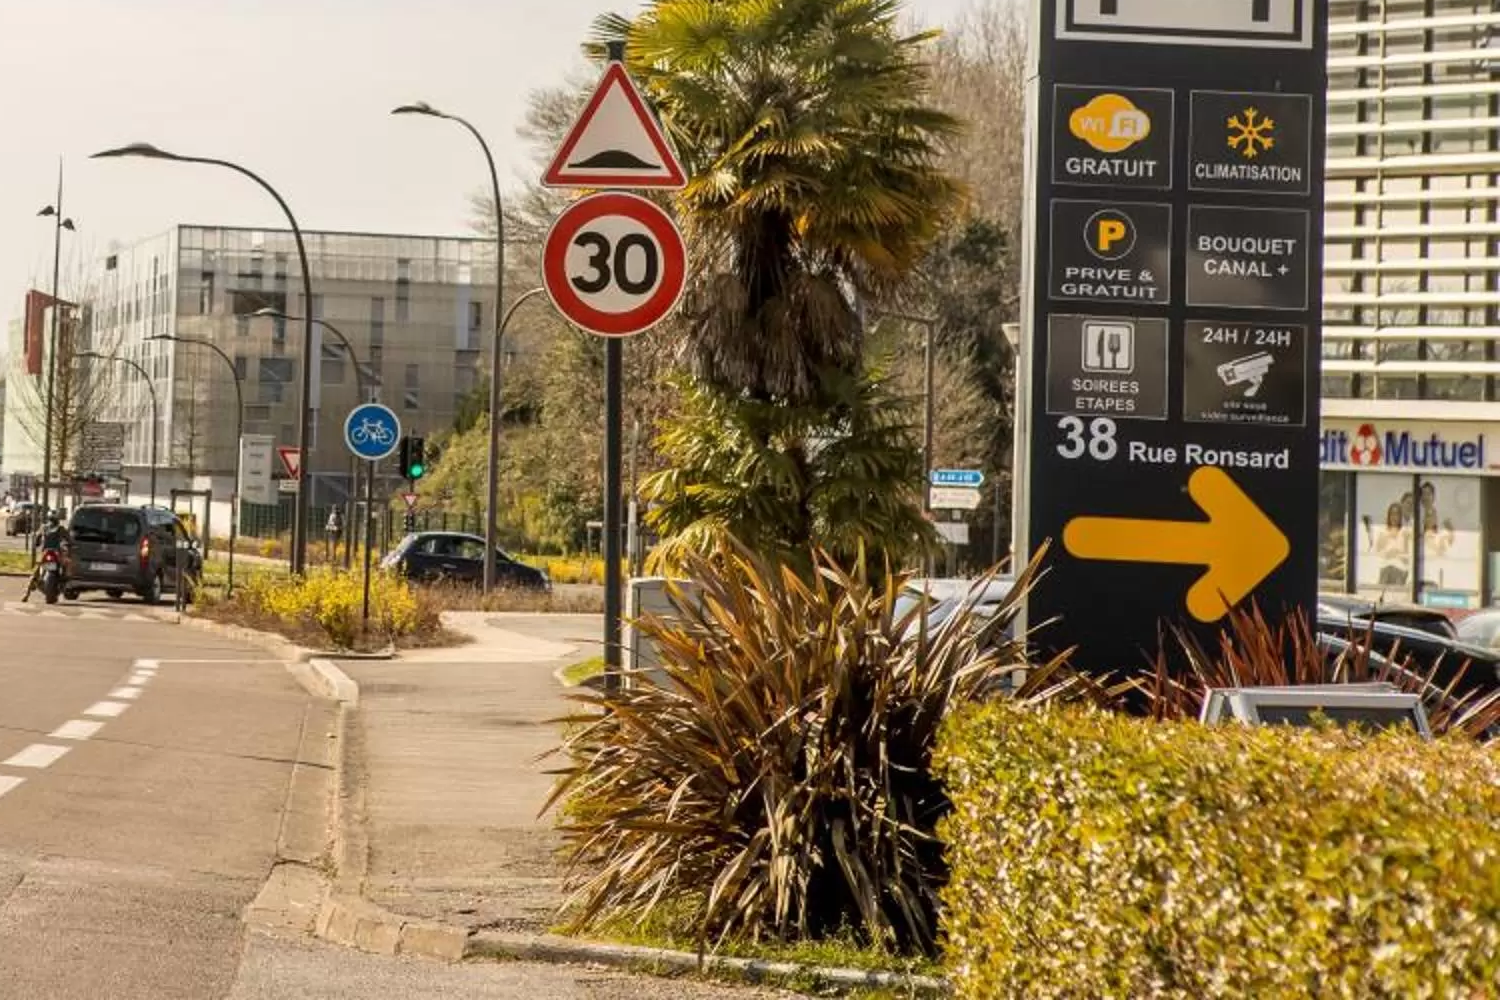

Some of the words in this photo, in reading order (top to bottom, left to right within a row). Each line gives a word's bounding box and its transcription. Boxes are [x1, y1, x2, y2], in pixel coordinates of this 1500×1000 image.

[1065, 157, 1156, 177] GRATUIT
[1195, 164, 1301, 181] CLIMATISATION
[1099, 219, 1126, 251] P
[1198, 236, 1297, 255] BOUQUET
[571, 231, 659, 295] 30
[1203, 259, 1272, 277] CANAL
[1065, 267, 1131, 281] PRIVE
[1138, 270, 1154, 282] &
[1061, 283, 1158, 299] GRATUIT
[1203, 328, 1238, 344] 24H
[1255, 330, 1291, 346] 24H
[1072, 378, 1140, 394] SOIREES
[1075, 397, 1136, 412] ETAPES
[1056, 416, 1118, 461] 38
[1129, 441, 1177, 463] Rue
[1185, 444, 1289, 469] Ronsard
[1385, 432, 1483, 468] Mutuel
